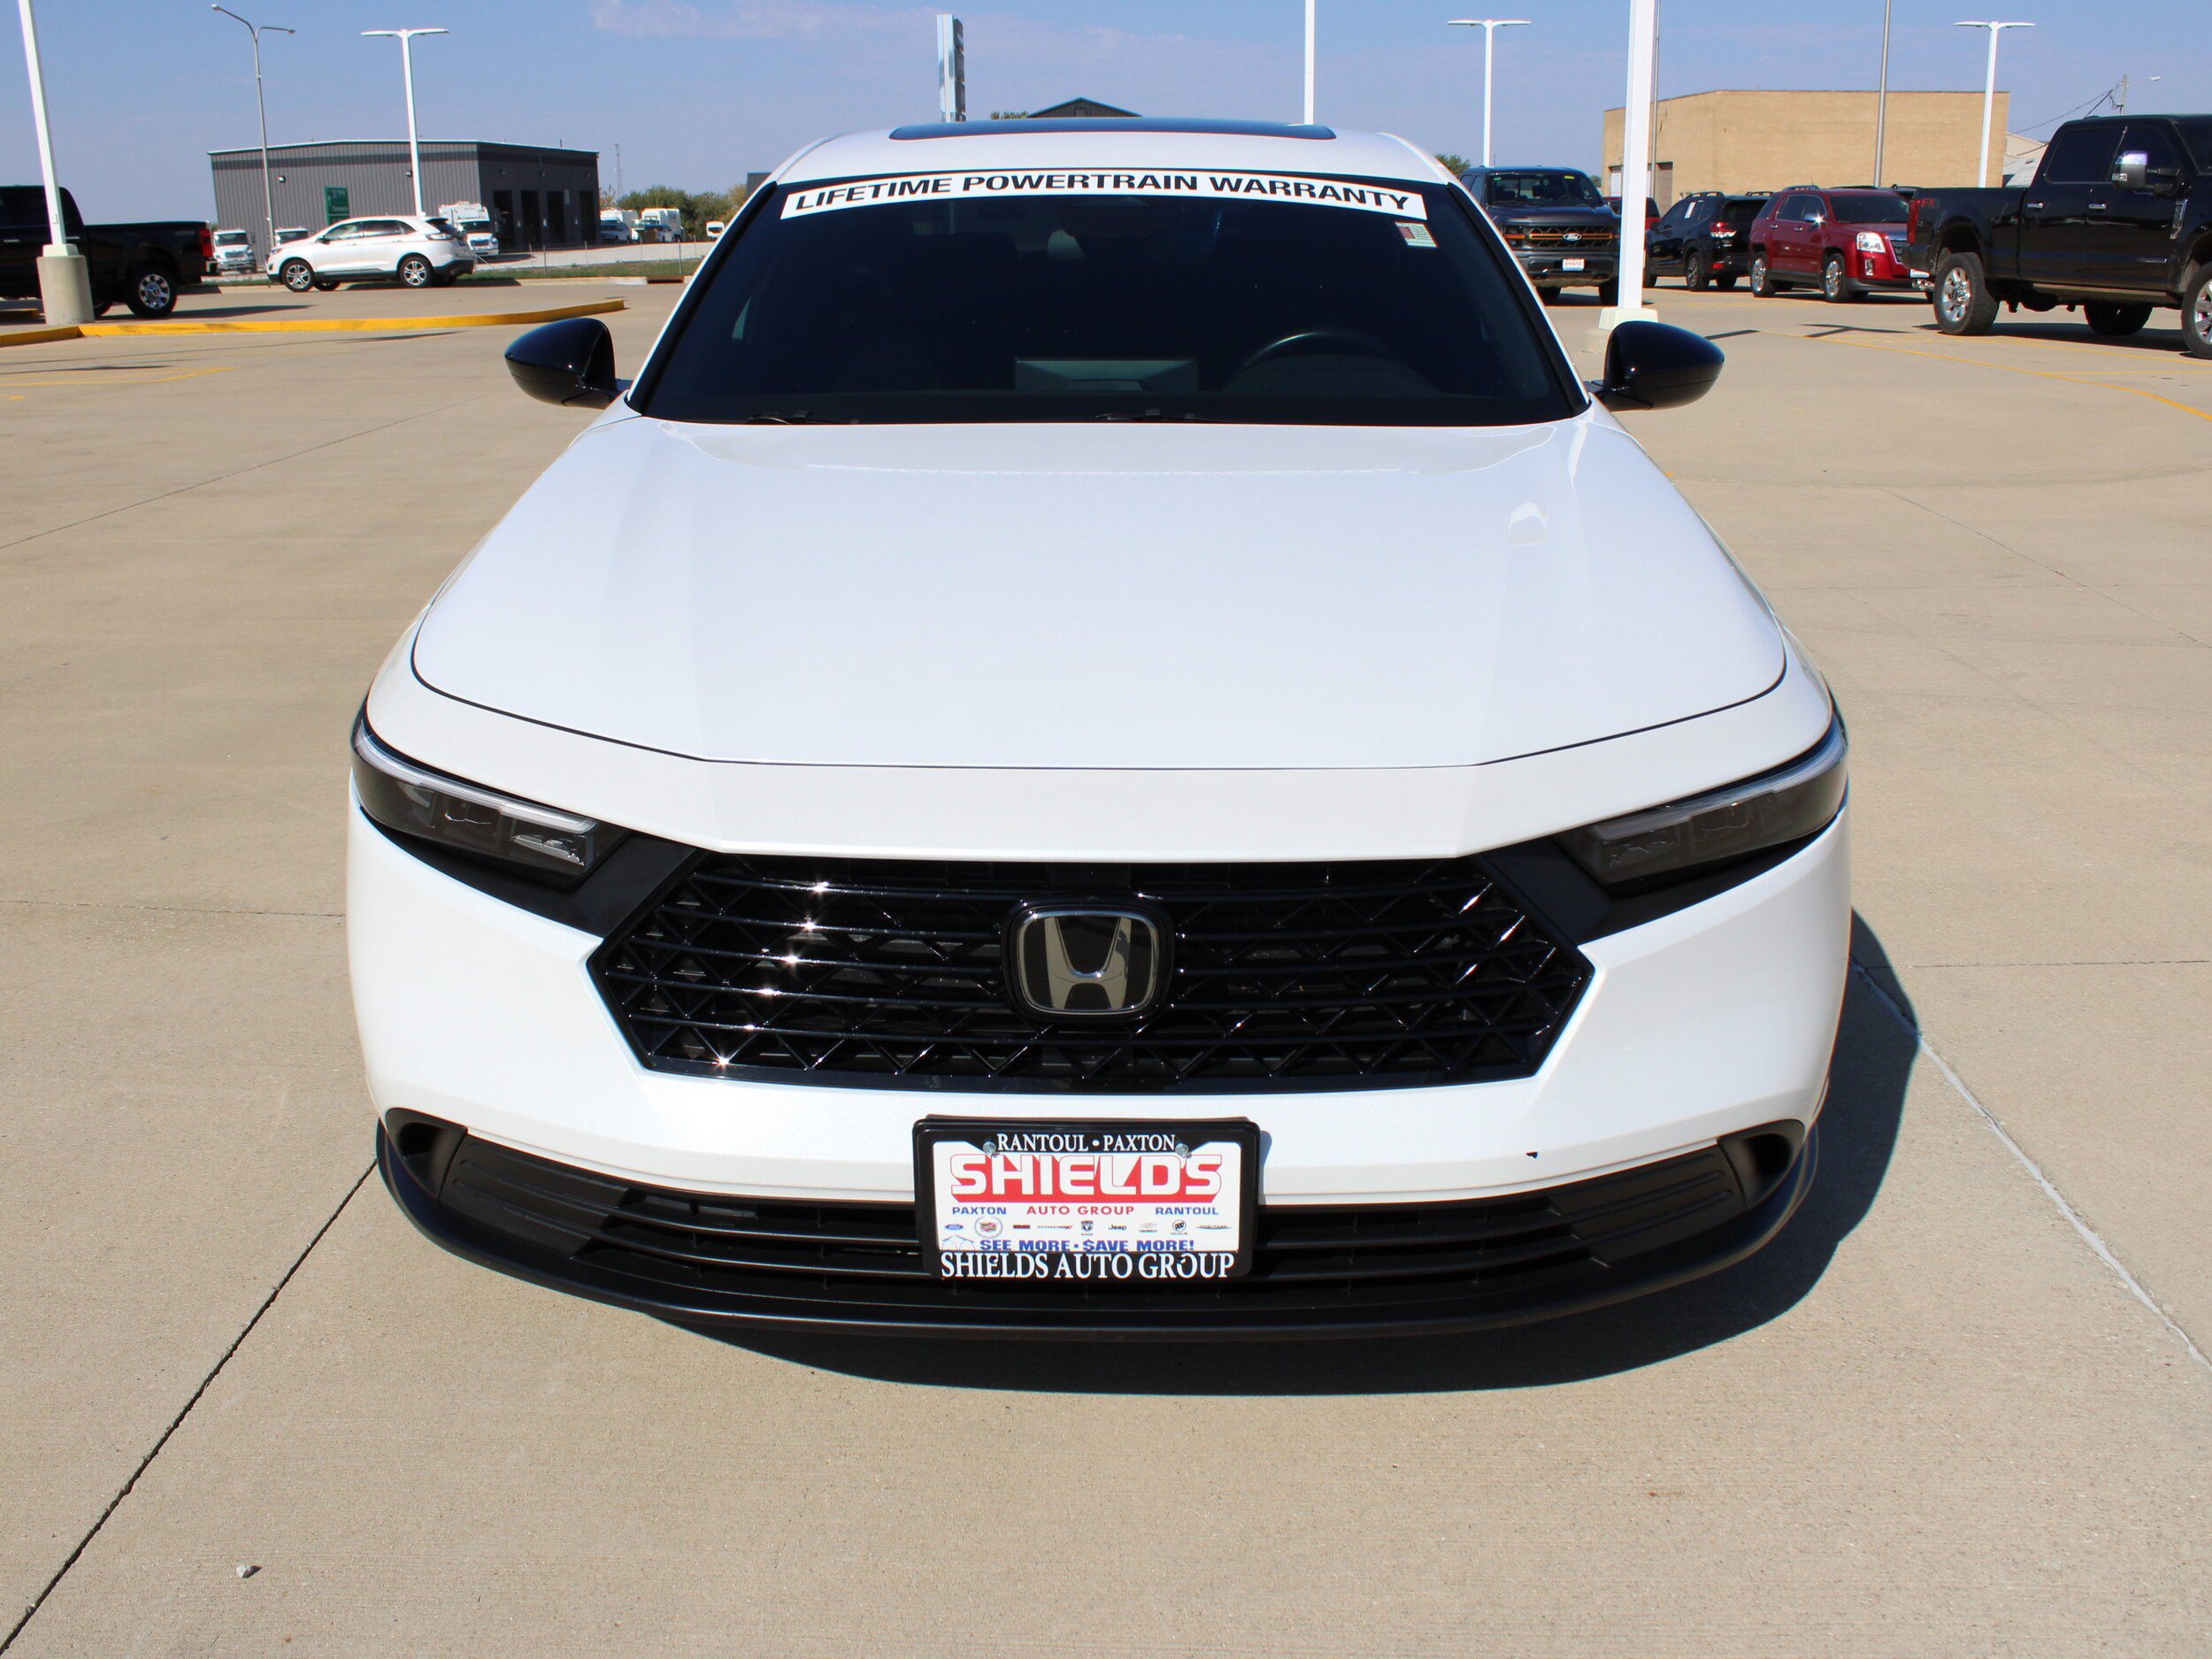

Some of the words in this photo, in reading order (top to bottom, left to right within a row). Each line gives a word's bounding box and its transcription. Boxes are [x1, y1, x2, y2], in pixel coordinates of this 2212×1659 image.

[795, 178, 952, 211] LIFETIME
[963, 174, 1198, 192] POWERTRAIN
[1210, 177, 1409, 211] WARRANTY
[997, 1133, 1089, 1152] RANTOUL
[1103, 1134, 1176, 1152] PAXTON
[949, 1153, 1223, 1203] SHIELDS
[952, 1206, 1007, 1215] PAXTON
[1026, 1205, 1071, 1215] AUTO
[1077, 1206, 1134, 1216] GROUP
[979, 1240, 1012, 1251] SEE
[1018, 1240, 1071, 1252] MORE
[1082, 1239, 1129, 1252] $AVE
[1136, 1240, 1194, 1251] MORE!
[941, 1252, 1050, 1278] SHIELDS
[1054, 1253, 1133, 1279] AUTO
[1138, 1253, 1235, 1279] GROUP
